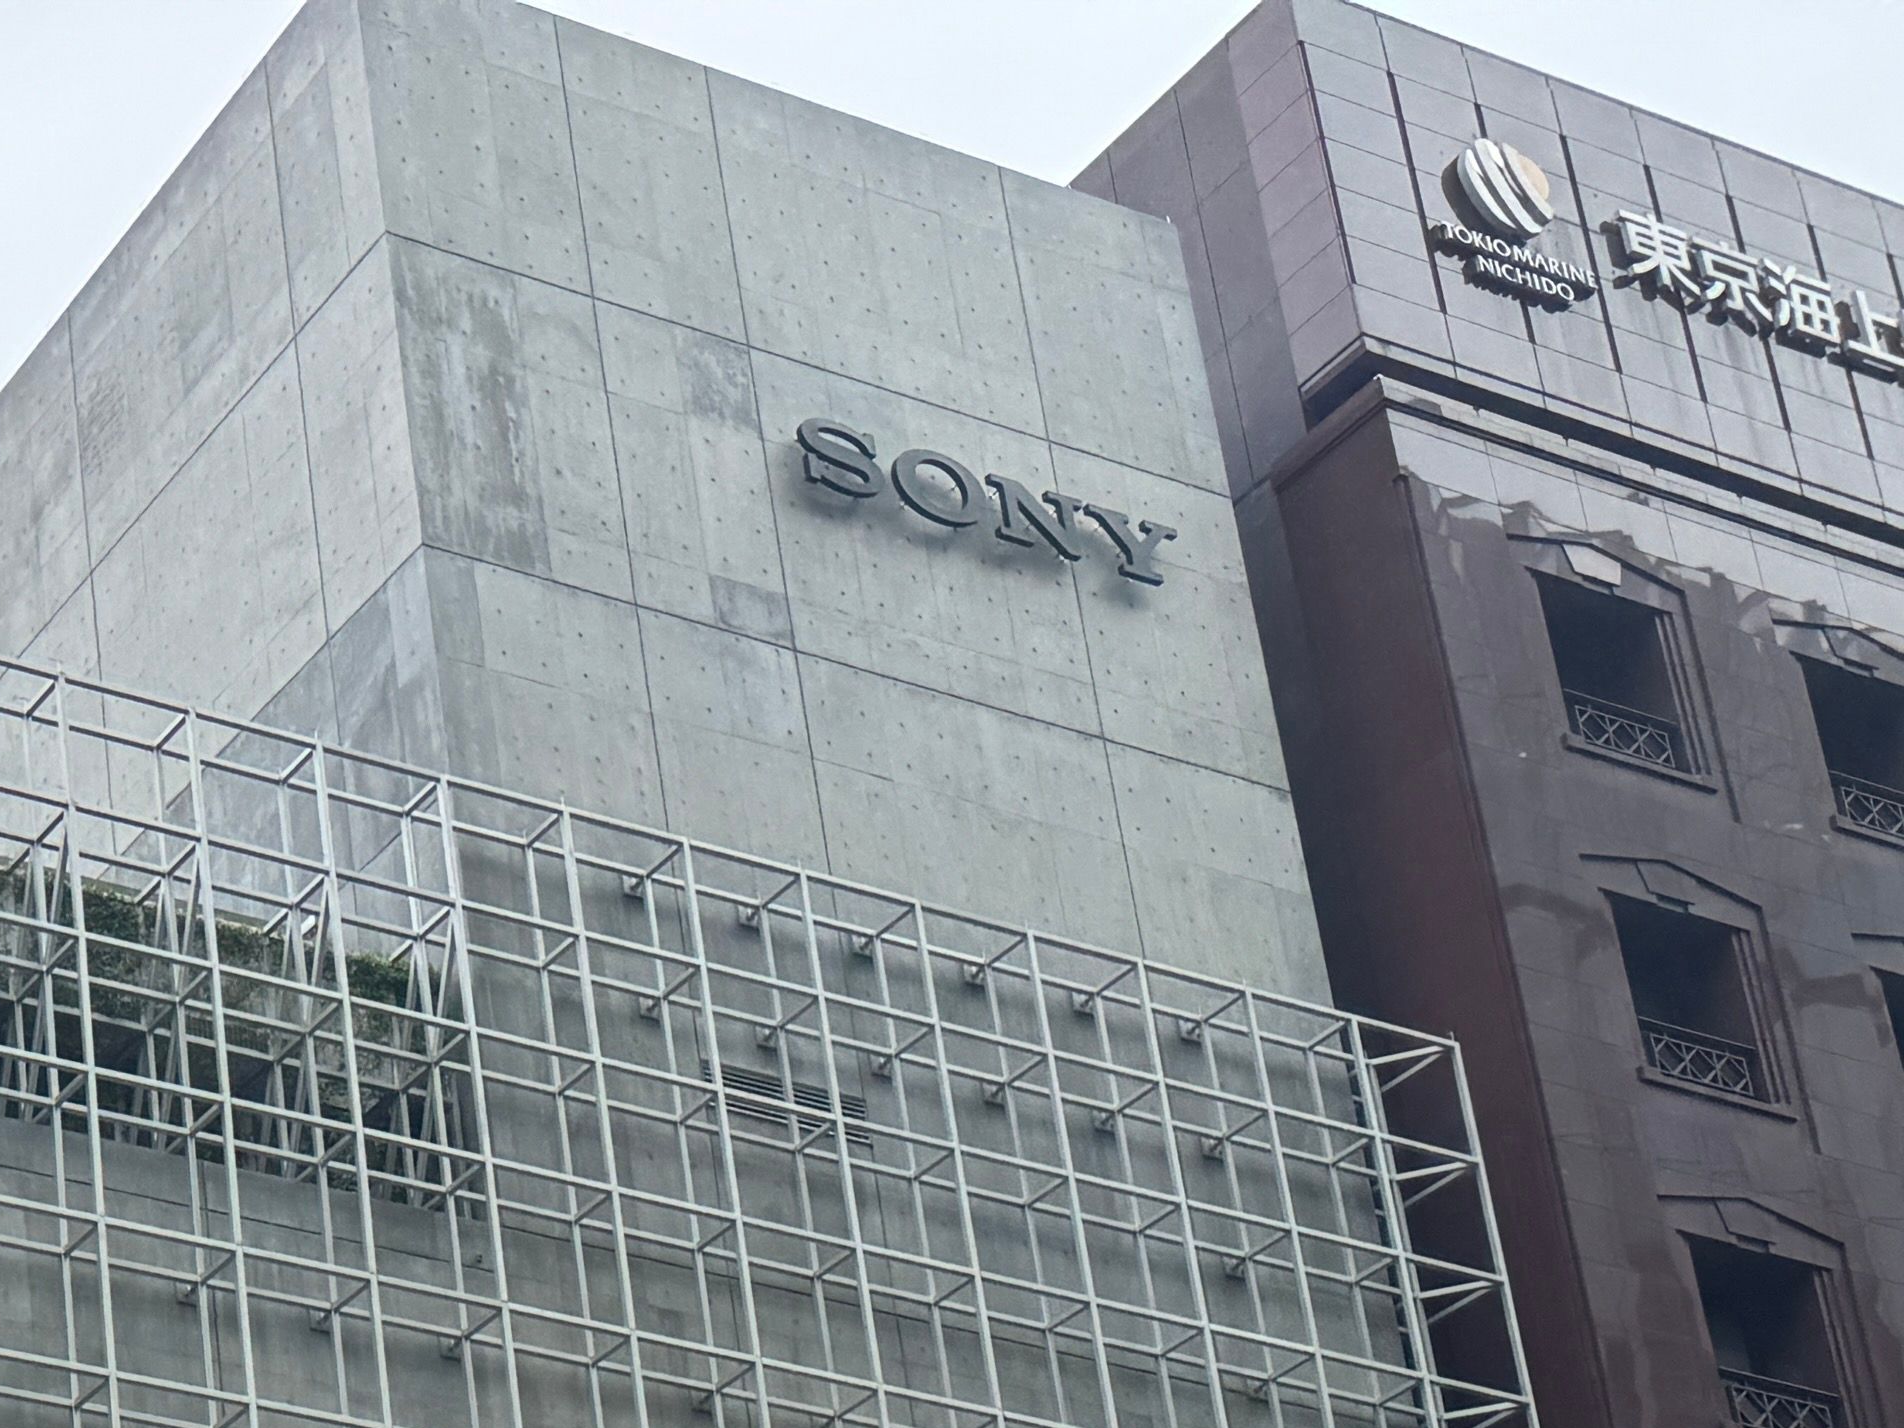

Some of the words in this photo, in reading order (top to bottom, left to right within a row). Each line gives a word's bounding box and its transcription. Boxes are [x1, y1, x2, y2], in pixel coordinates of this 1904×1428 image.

[1439, 221, 1511, 259] TOKIO
[1512, 244, 1599, 290] MARINE
[1476, 254, 1576, 302] NICHIDO
[796, 417, 1178, 587] SONY
